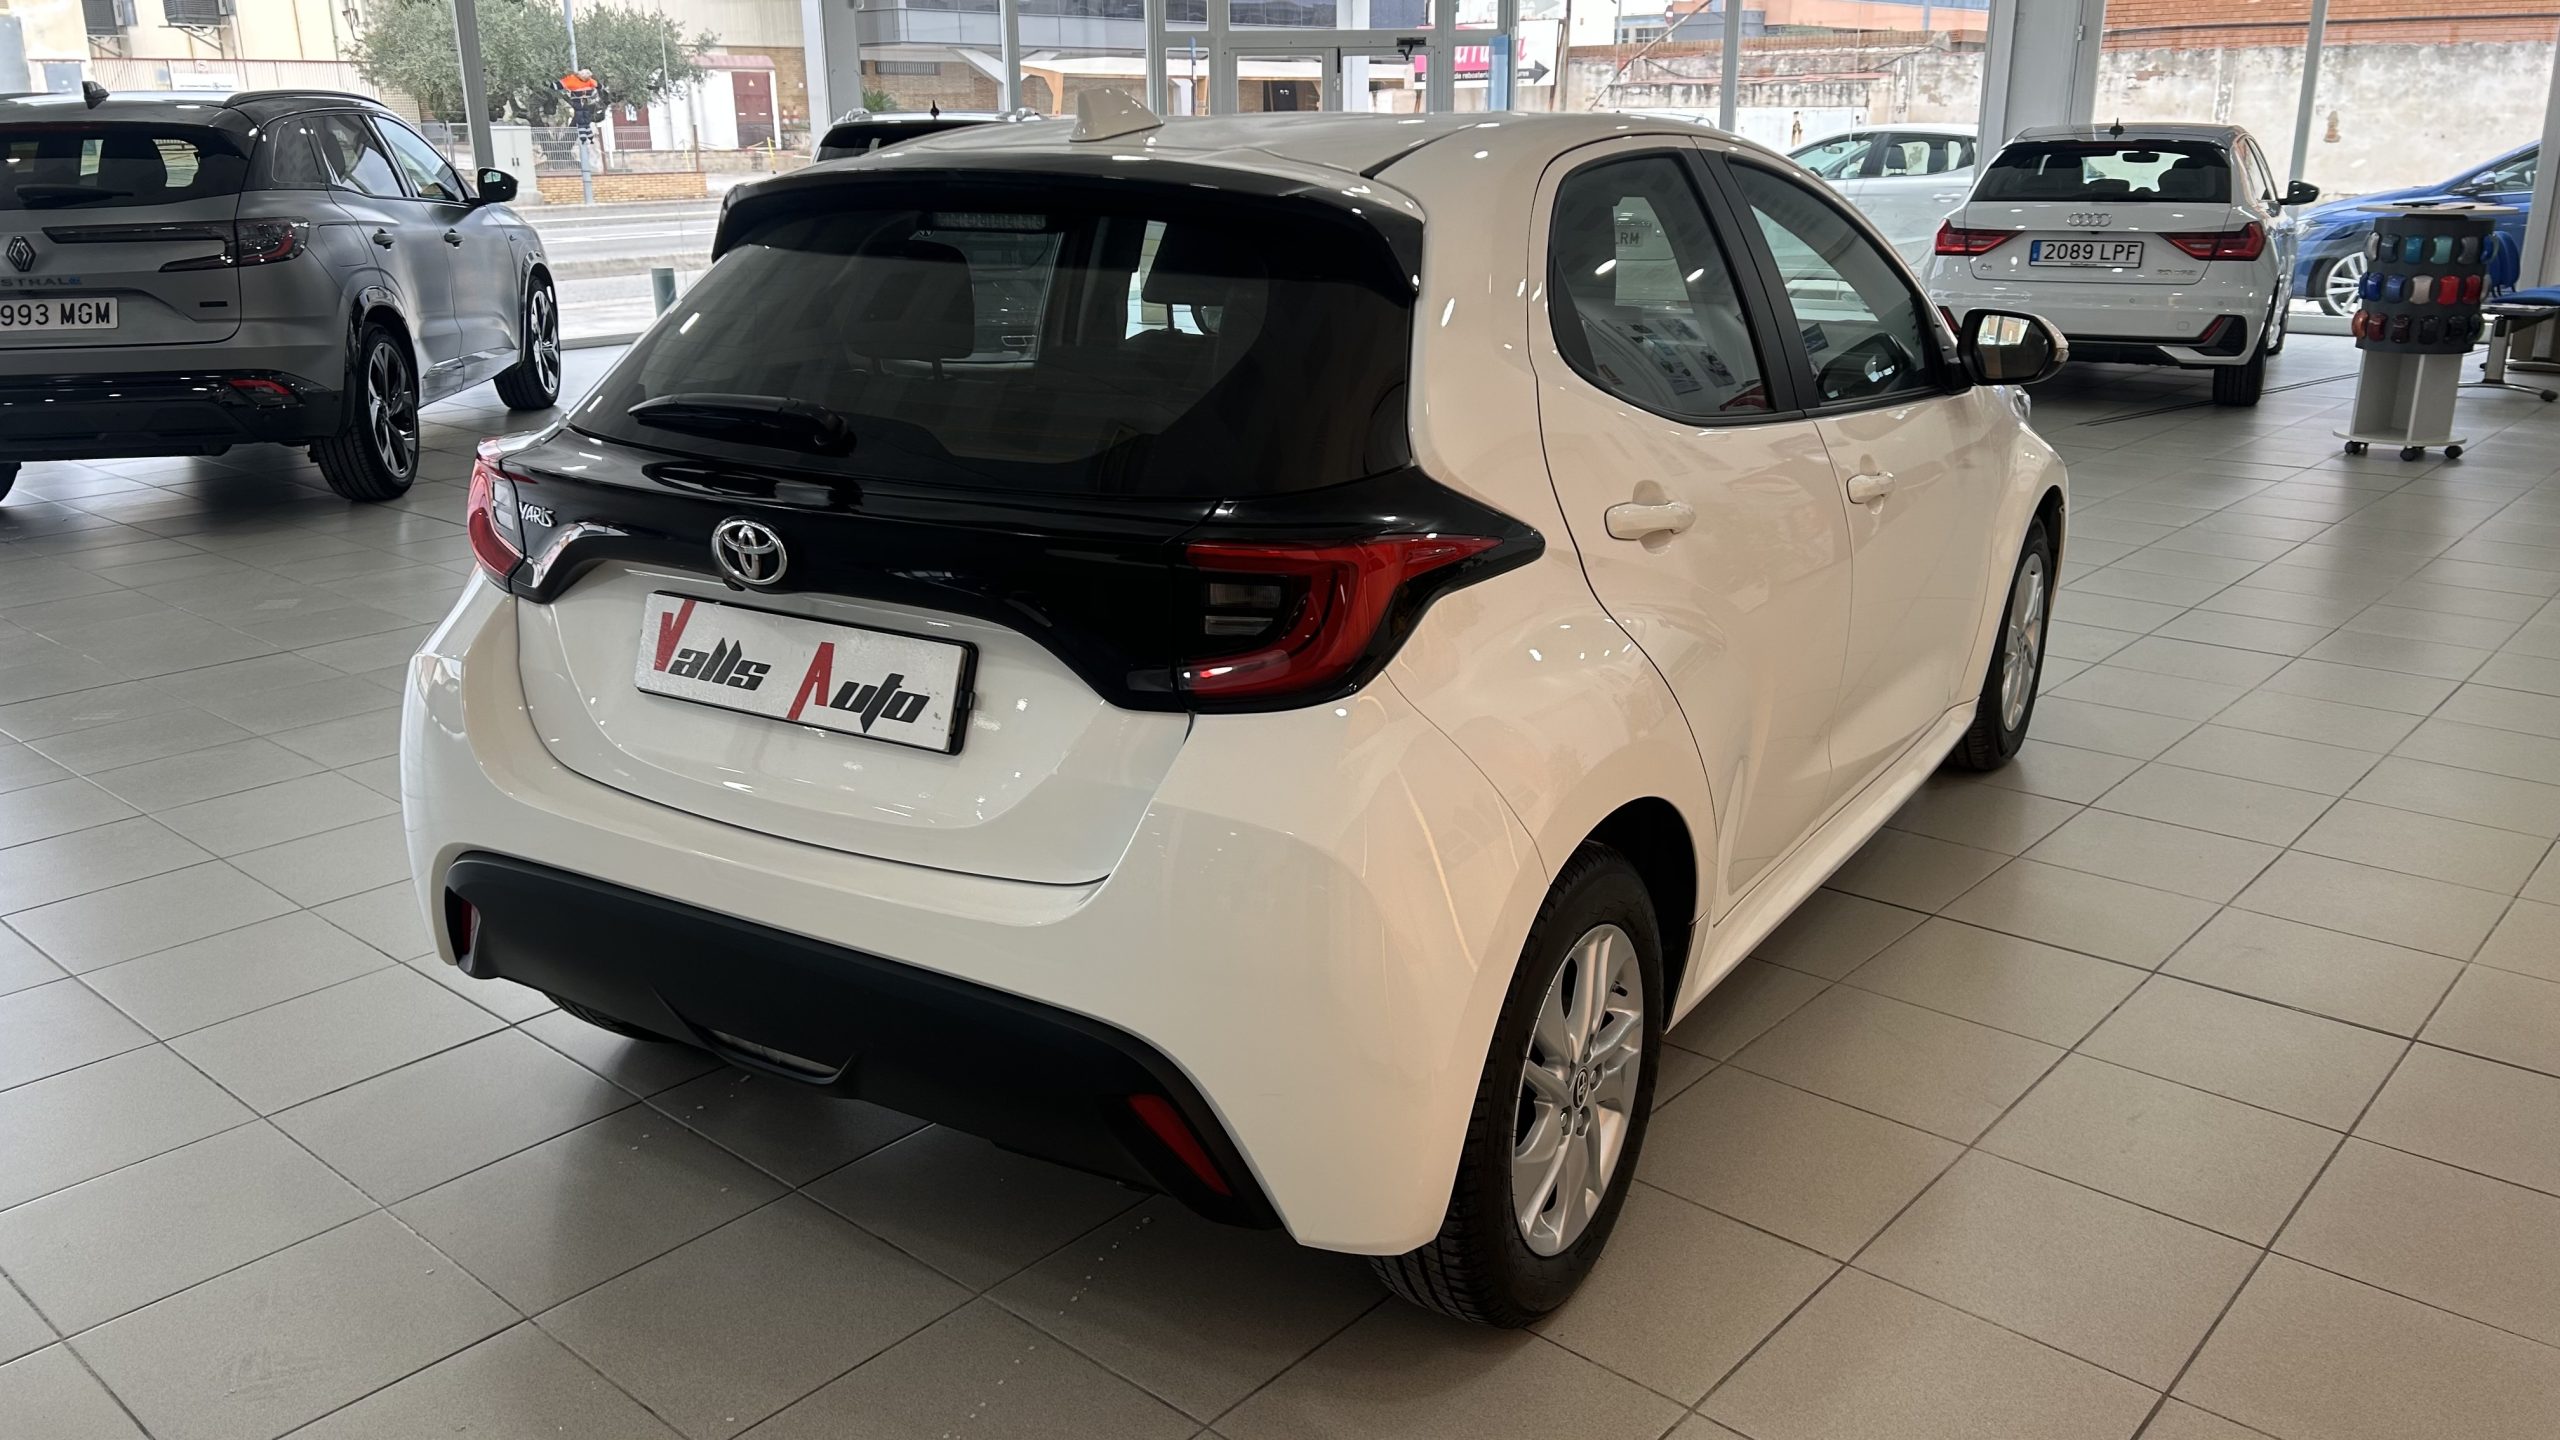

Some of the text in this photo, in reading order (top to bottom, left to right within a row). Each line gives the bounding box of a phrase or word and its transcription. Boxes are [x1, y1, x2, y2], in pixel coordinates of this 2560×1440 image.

[1616, 232, 1640, 245] RM
[2043, 243, 2138, 261] 2089 LPF
[0, 302, 110, 326] 993 MGM
[654, 599, 931, 733] Valls Auto
